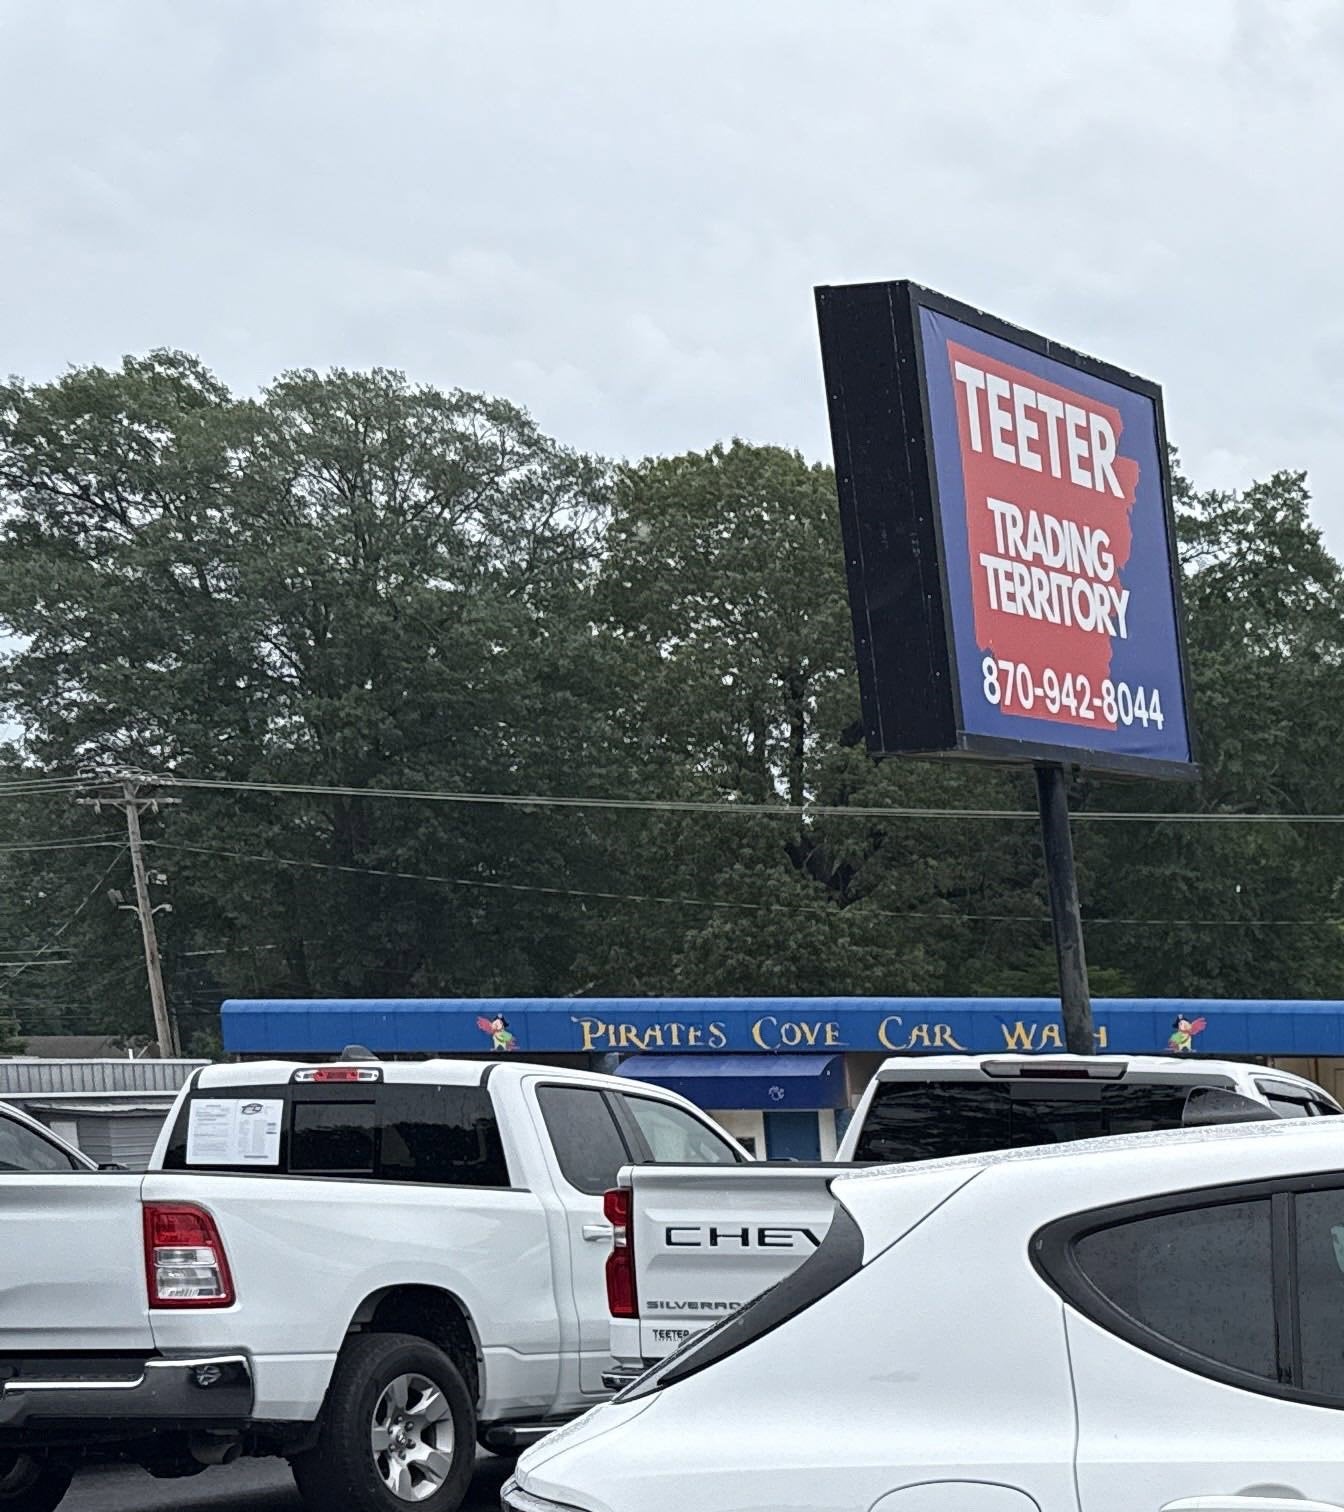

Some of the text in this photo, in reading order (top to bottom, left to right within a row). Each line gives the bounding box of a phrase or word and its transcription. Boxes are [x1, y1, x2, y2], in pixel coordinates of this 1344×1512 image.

[955, 361, 1126, 499] TEETER
[986, 497, 1115, 582] TRADING
[979, 553, 1131, 640] TERRITORY
[981, 656, 1164, 730] 870-942-8044
[571, 1015, 1108, 1052] PIRATES COVE CAR WAH
[665, 1226, 822, 1248] CHEV
[646, 1301, 742, 1311] SILVERAD
